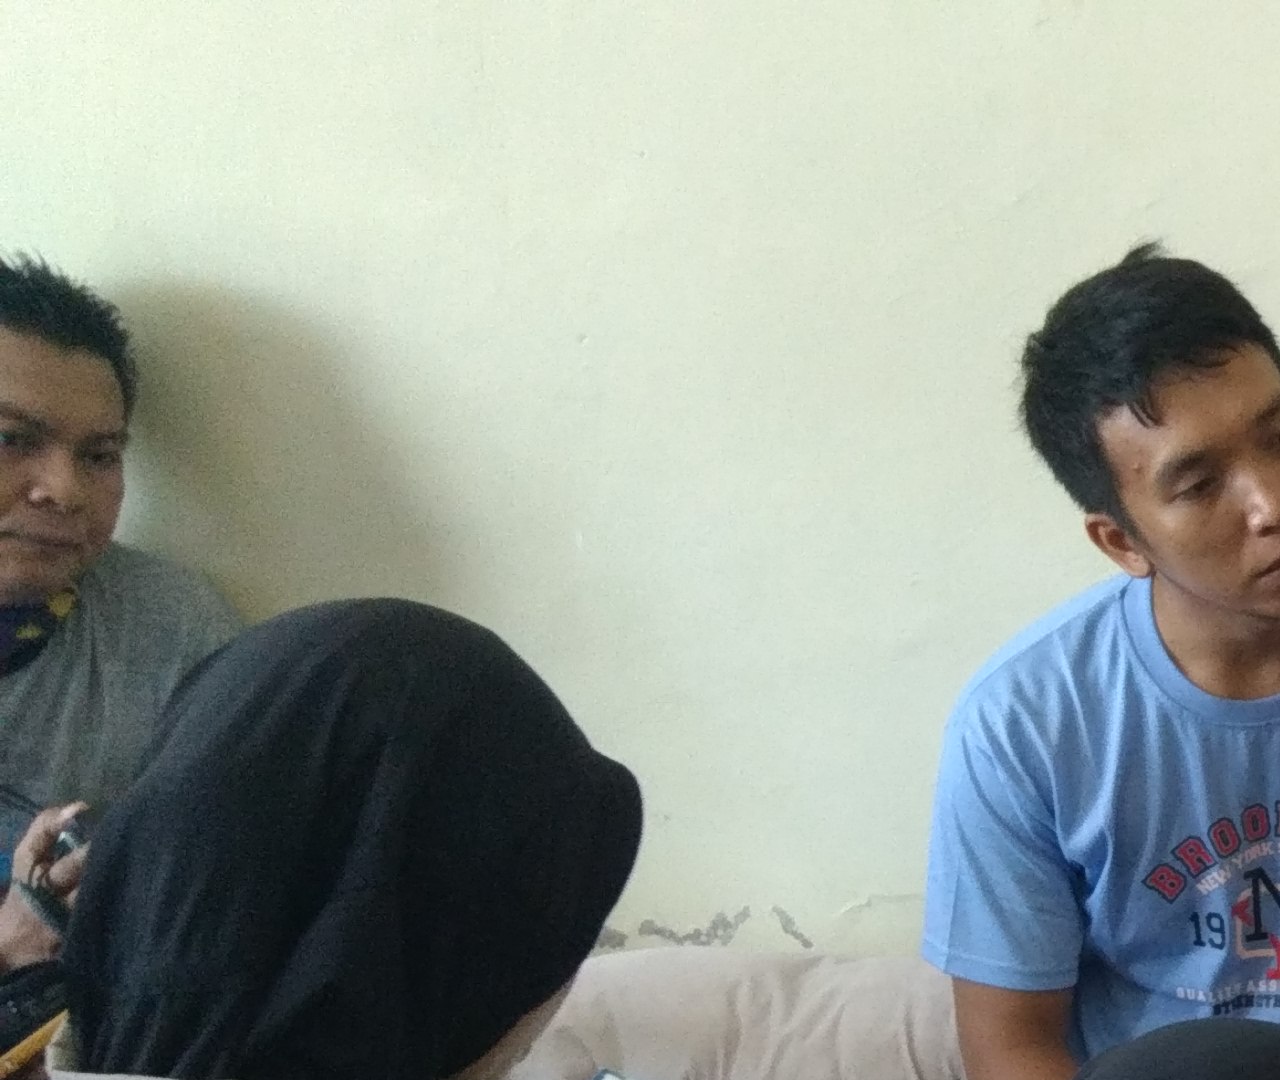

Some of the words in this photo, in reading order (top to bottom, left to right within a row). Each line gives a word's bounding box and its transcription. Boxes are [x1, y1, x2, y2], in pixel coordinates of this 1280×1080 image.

[1196, 866, 1231, 895] NEW
[1231, 841, 1274, 870] YORK
[1189, 911, 1226, 950] 19
